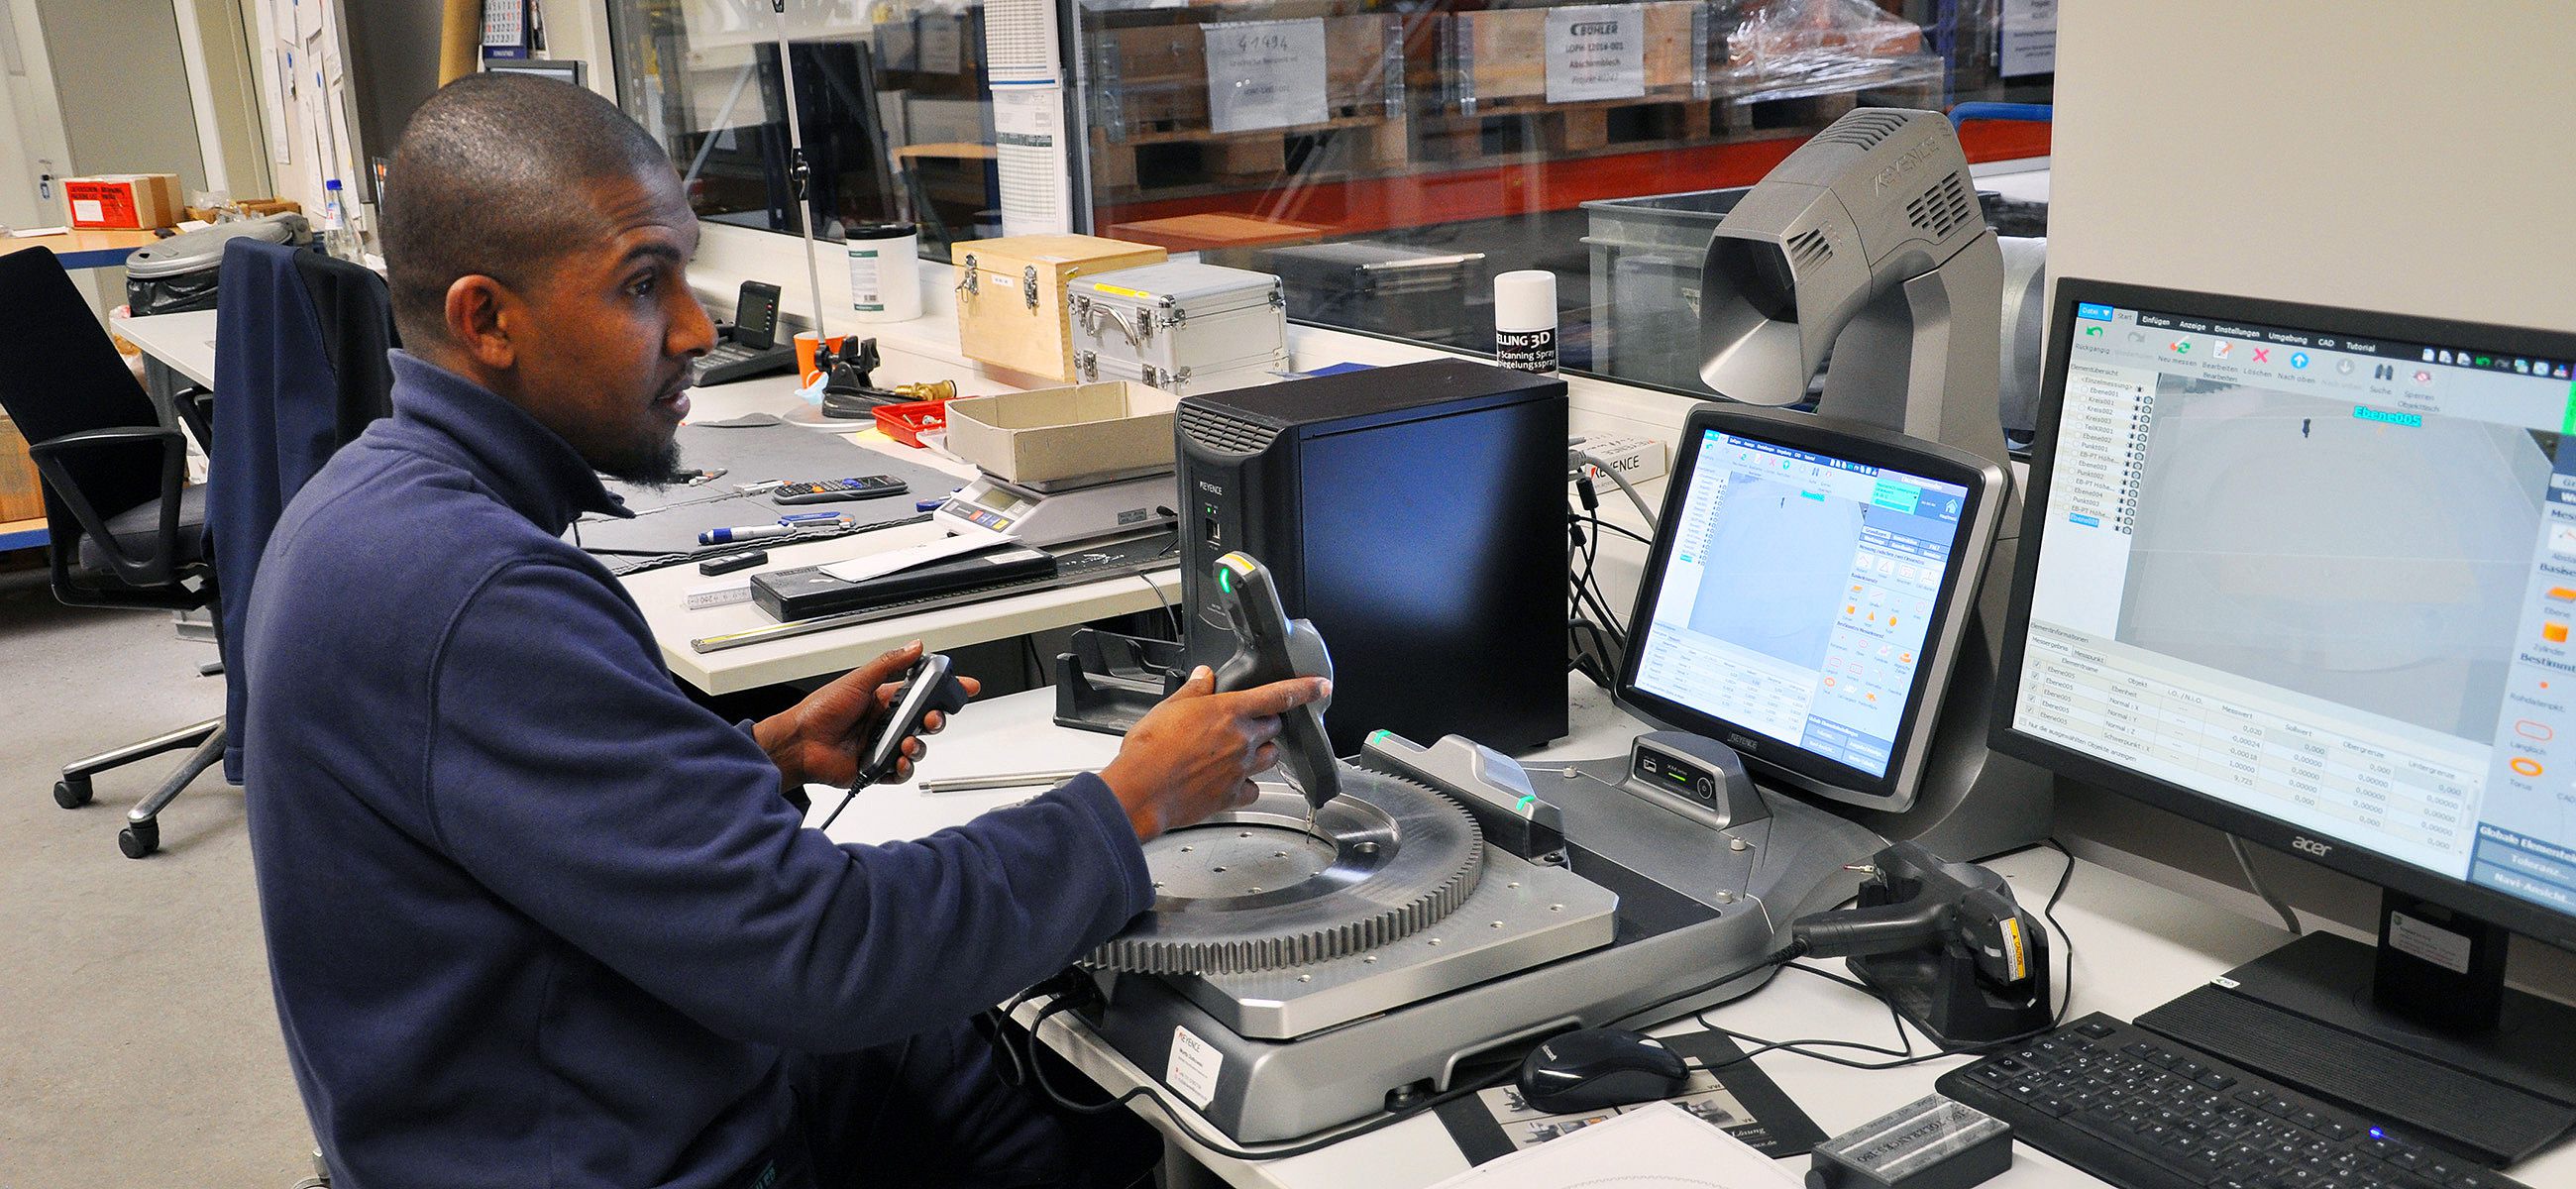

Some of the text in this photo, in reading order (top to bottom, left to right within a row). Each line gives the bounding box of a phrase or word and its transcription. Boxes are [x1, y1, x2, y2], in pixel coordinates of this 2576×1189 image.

[1531, 332, 1551, 349] 3D
[2142, 315, 2171, 327] Einfügen
[2179, 320, 2206, 331] Anzeige
[2213, 325, 2260, 338] Einstellungen
[2268, 332, 2308, 345] Umgebung
[2317, 338, 2334, 347] CAD
[2346, 341, 2376, 352] Tutorial
[1536, 350, 1555, 360] Spray
[2201, 362, 2238, 373] Bearbeiten
[2243, 368, 2272, 378] Löschen
[2354, 405, 2421, 427] Ebene005
[2292, 835, 2332, 857] acer
